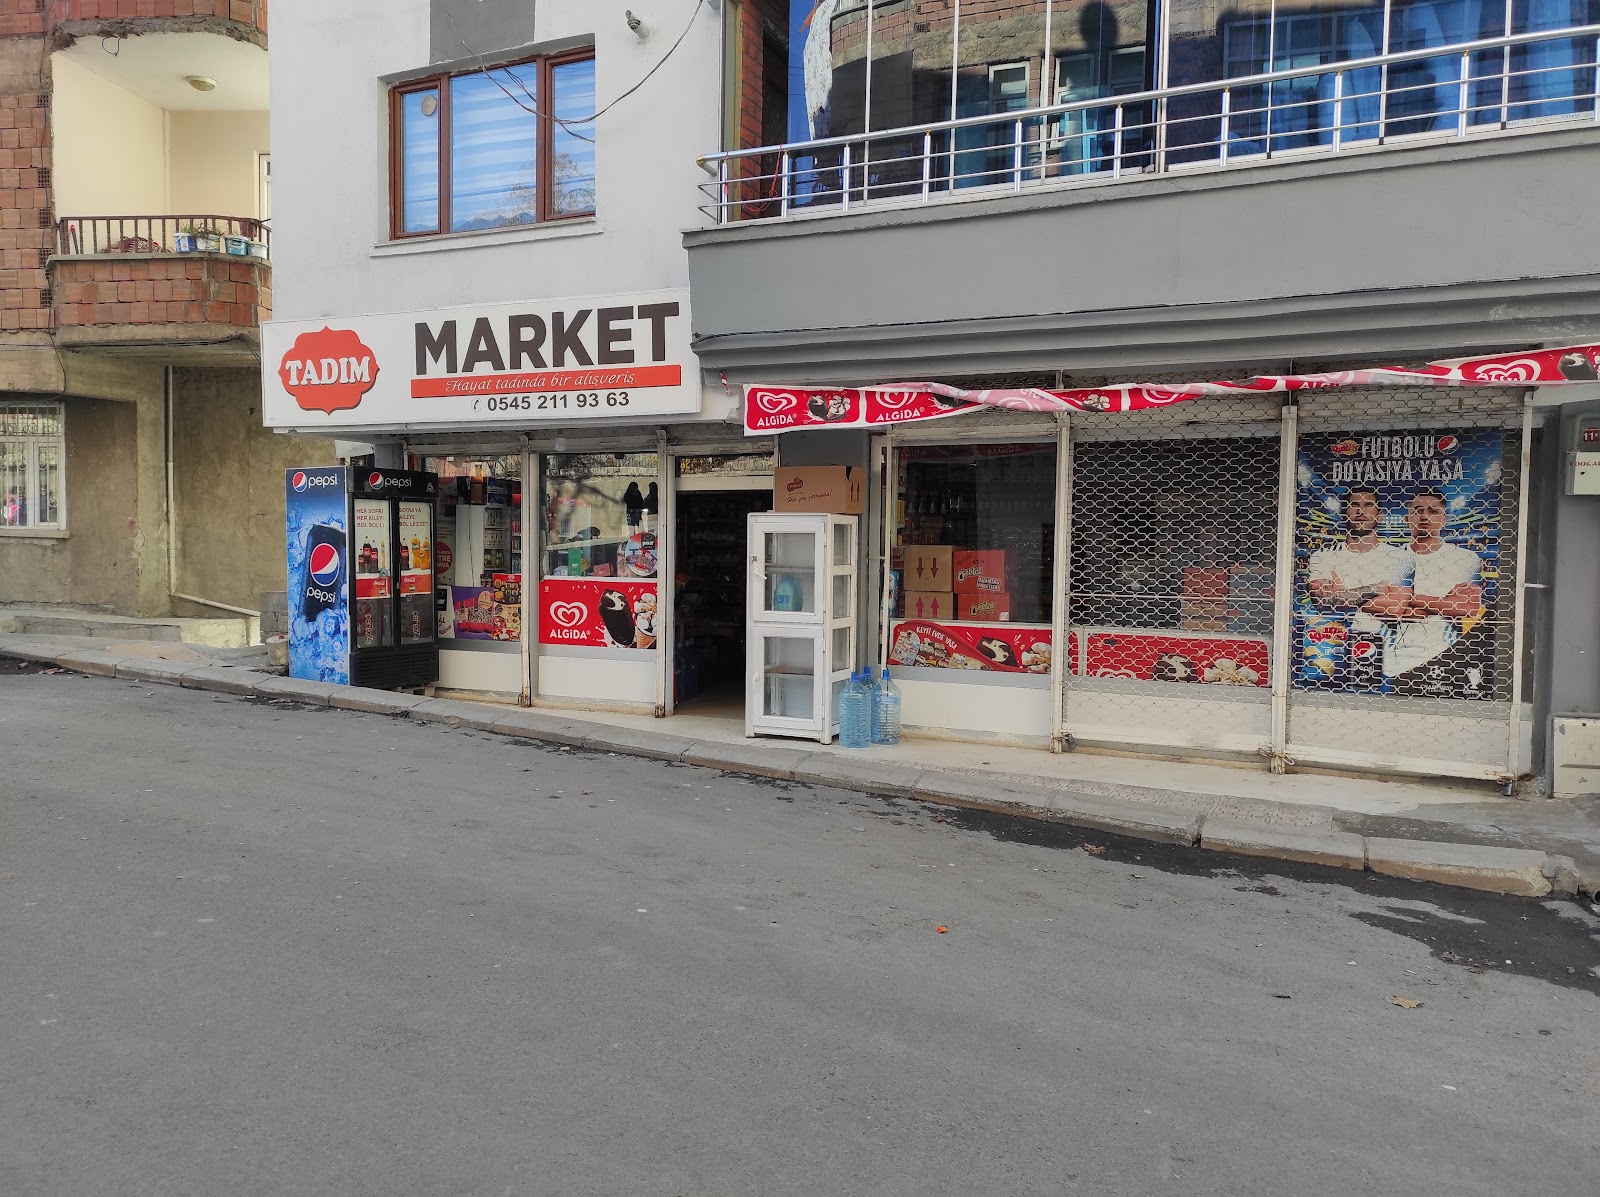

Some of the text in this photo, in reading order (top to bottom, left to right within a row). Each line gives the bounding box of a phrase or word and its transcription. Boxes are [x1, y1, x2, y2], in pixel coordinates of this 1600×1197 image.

[415, 302, 679, 375] MARKET
[285, 356, 371, 386] TADIM
[446, 379, 491, 393] Hayat
[551, 373, 572, 387] bir
[487, 391, 630, 411] 0545 211 93 63
[1362, 436, 1435, 458] FUTBOLU
[308, 473, 338, 488] pepsi
[384, 477, 412, 488] pepsi
[306, 587, 336, 603] pepsi
